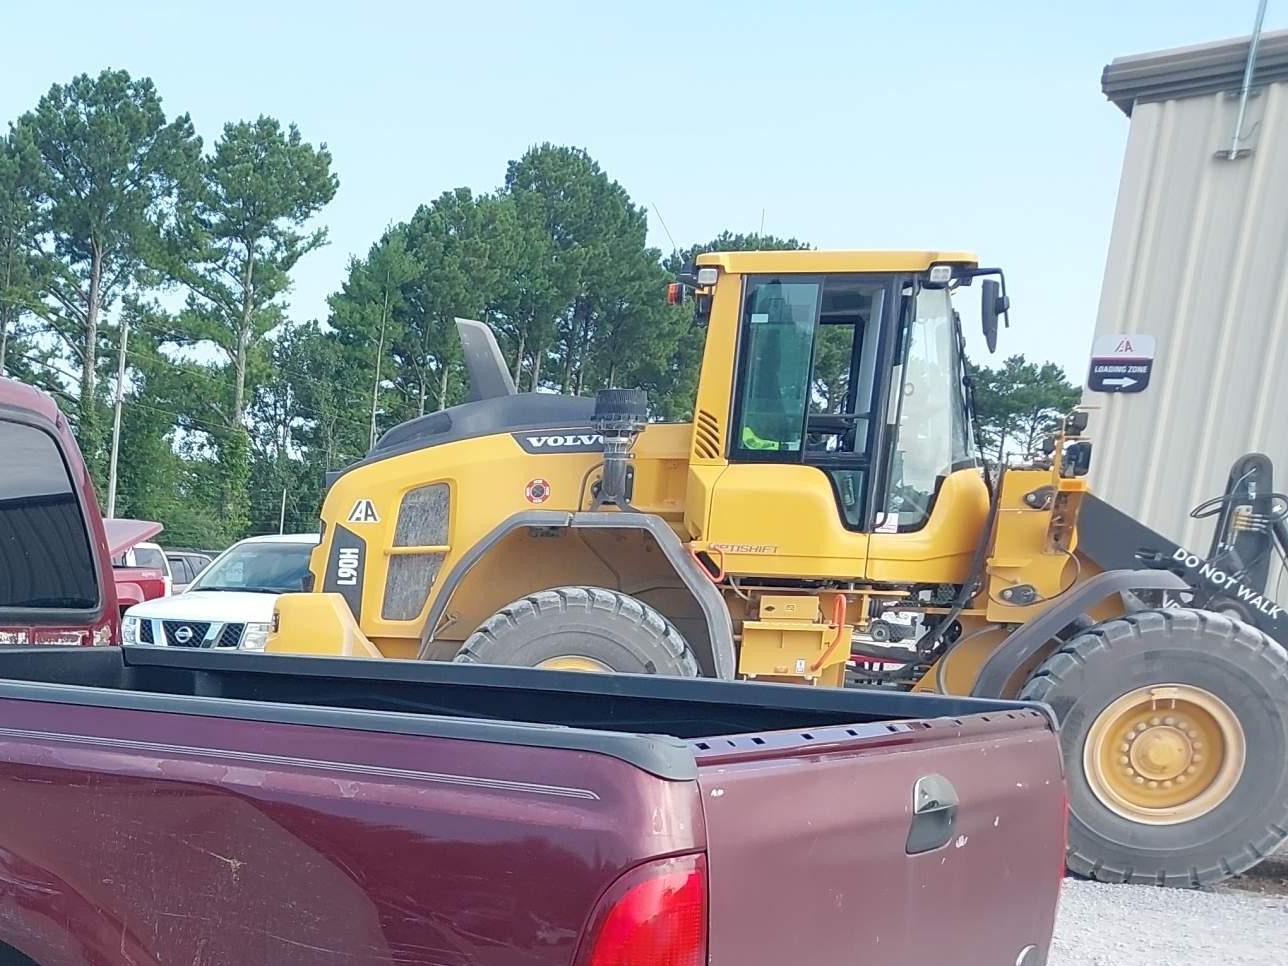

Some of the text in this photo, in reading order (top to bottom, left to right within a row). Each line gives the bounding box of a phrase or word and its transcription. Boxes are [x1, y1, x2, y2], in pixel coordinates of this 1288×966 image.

[336, 548, 360, 585] L90H
[1172, 547, 1284, 619] DO NOT WALK
